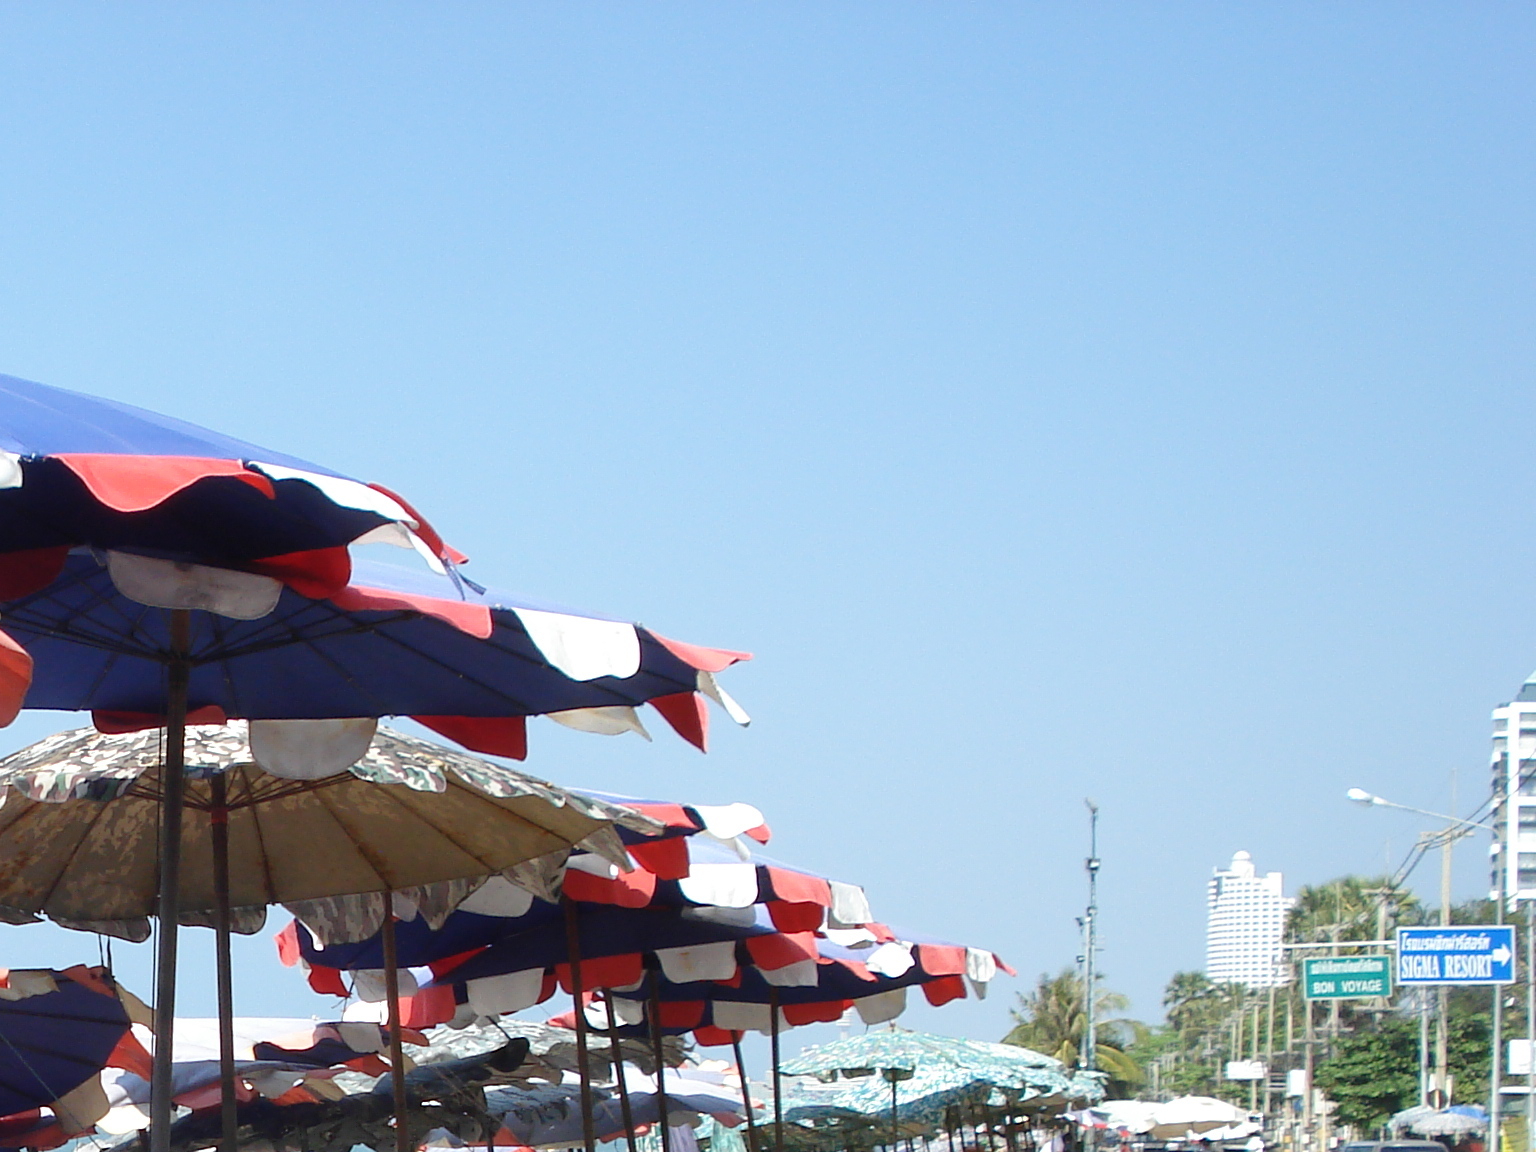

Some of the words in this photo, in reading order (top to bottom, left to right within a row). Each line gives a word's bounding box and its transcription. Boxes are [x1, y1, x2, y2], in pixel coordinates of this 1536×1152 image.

[1401, 955, 1440, 978] SIGMA
[1444, 955, 1492, 978] RESORT
[1313, 981, 1335, 994] BON
[1342, 979, 1383, 993] VOYAGE
